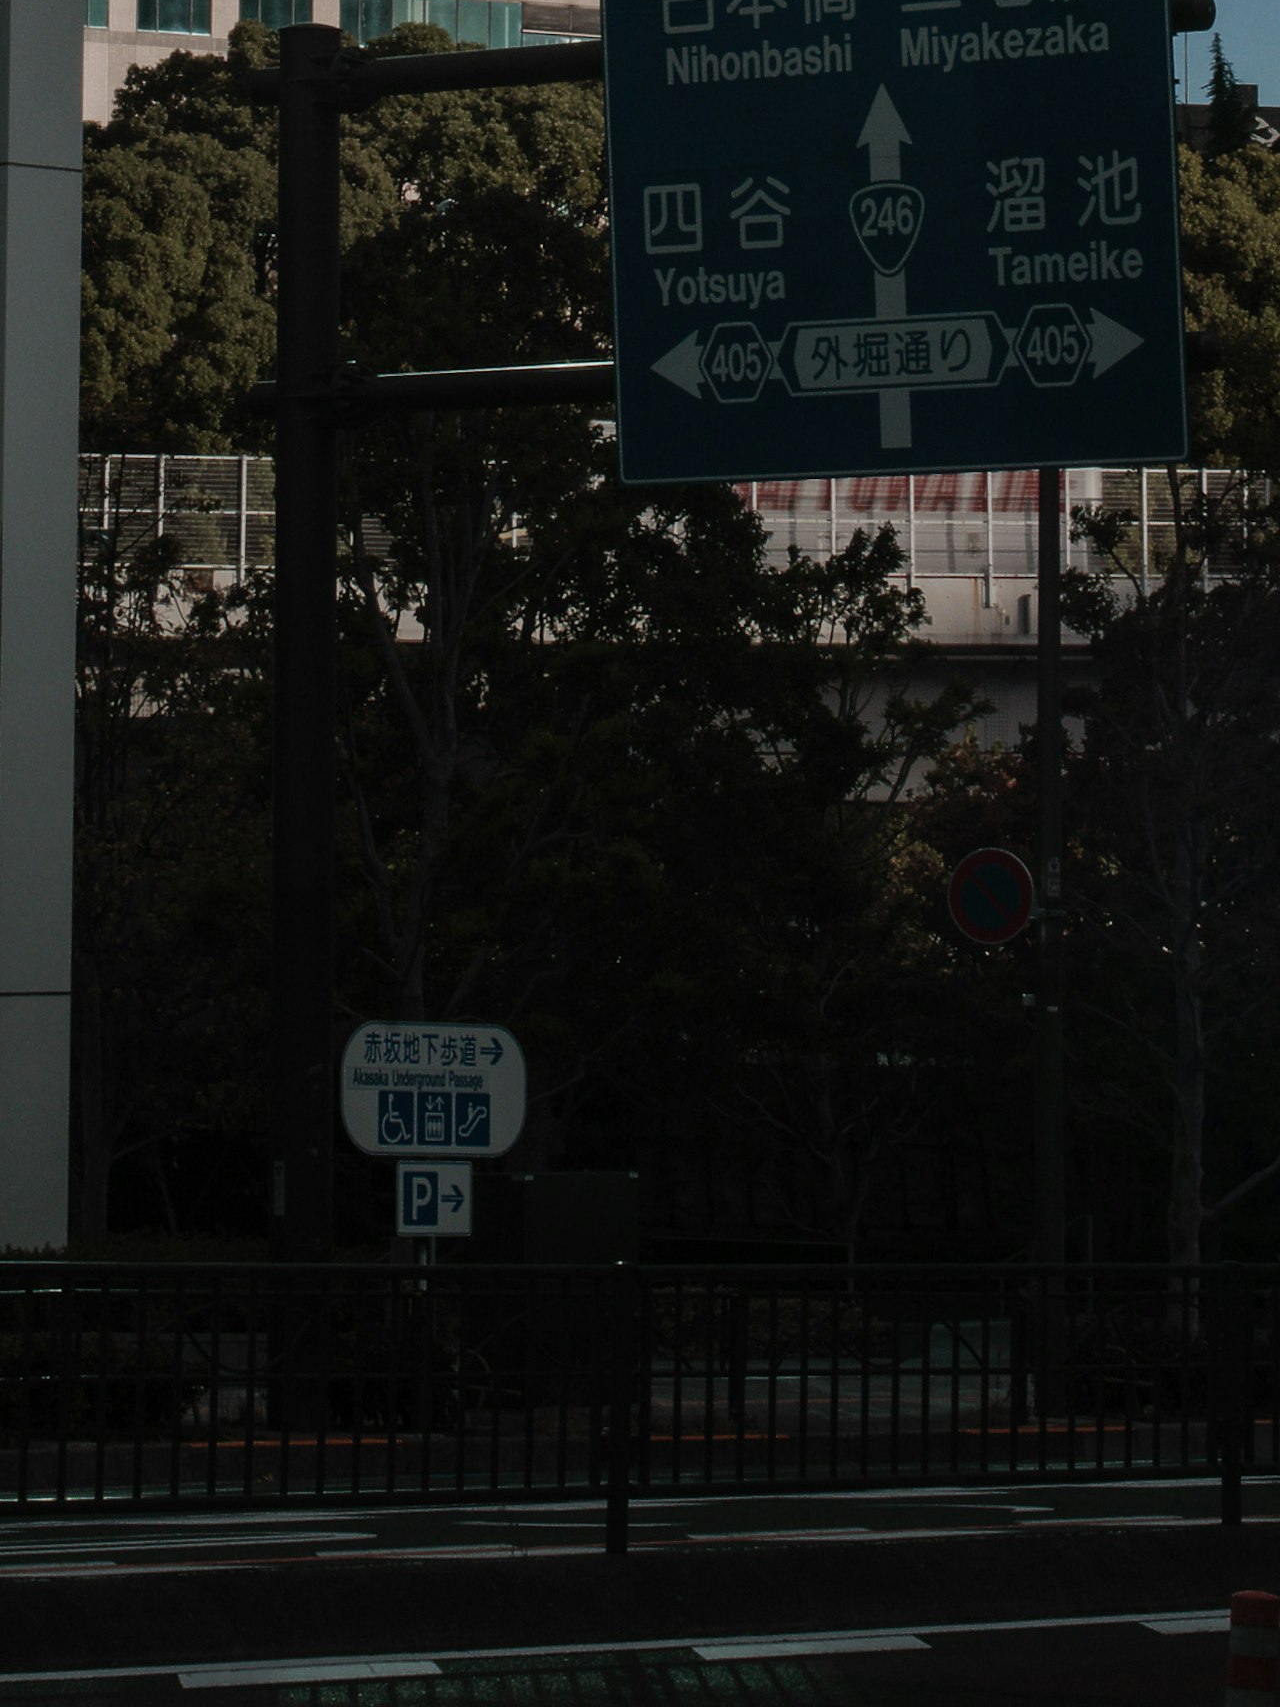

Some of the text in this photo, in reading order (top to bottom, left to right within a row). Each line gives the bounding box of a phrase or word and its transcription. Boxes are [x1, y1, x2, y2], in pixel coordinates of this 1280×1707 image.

[665, 17, 1110, 85] Nihonbashi Miyakezaka
[984, 149, 1143, 233] 溜池
[643, 175, 791, 255] 四谷
[860, 196, 914, 238] 246
[988, 241, 1144, 286] Tameike
[654, 267, 787, 310] Yotsuya
[712, 344, 763, 384] 405
[812, 328, 971, 380] 外堀通り
[1026, 325, 1080, 366] 405
[364, 1032, 478, 1066] 赤坂地下歩道
[352, 1068, 484, 1091] Akasaka Underground Passage
[412, 1175, 433, 1221] P
